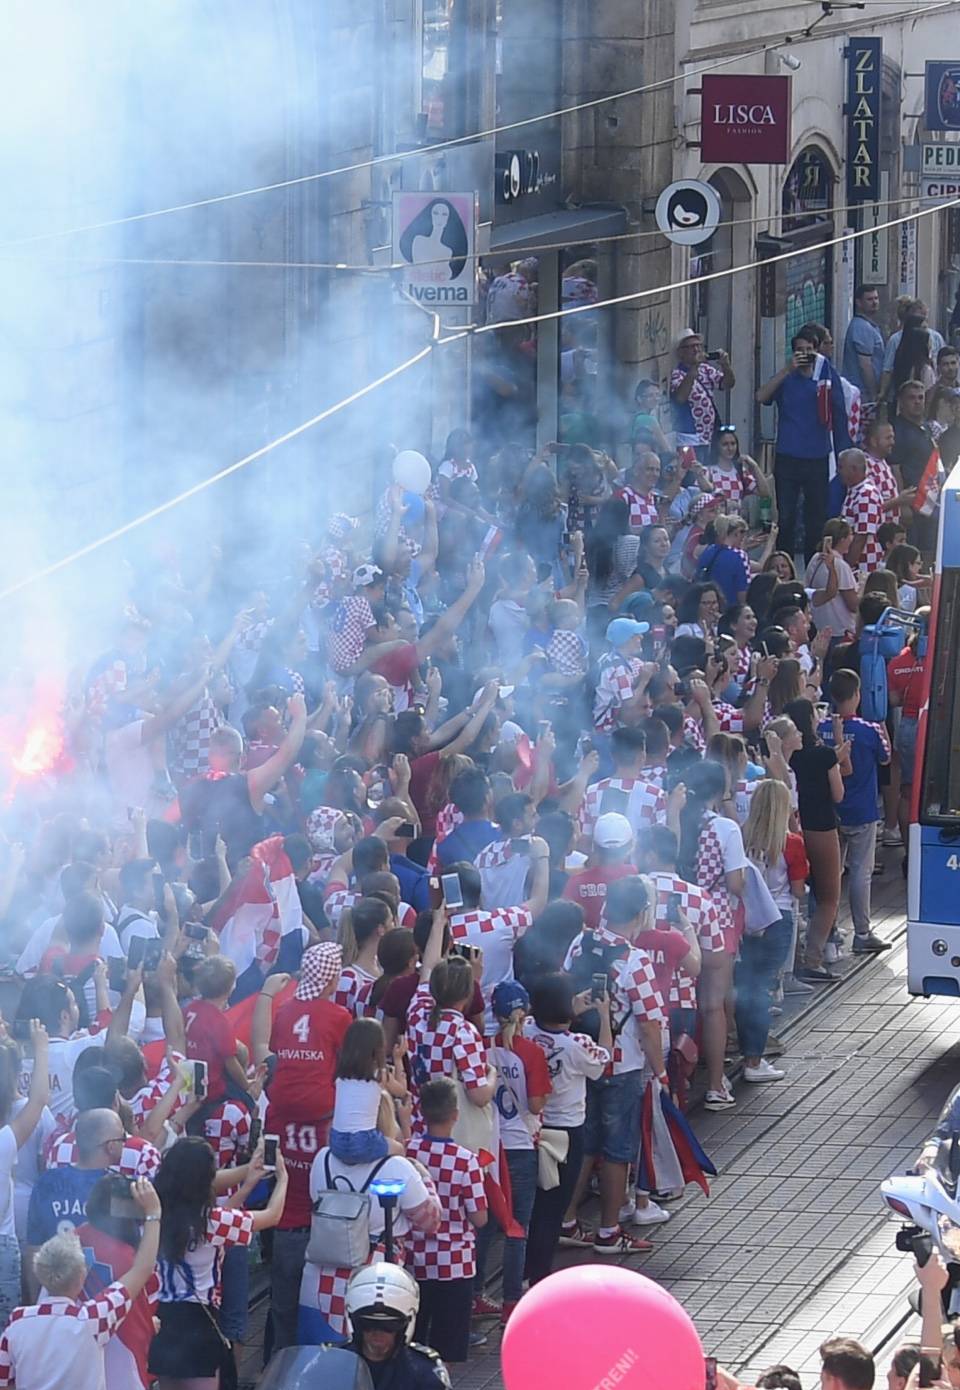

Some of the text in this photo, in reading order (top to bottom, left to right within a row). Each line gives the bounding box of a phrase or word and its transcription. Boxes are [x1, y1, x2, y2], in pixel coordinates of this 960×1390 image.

[713, 104, 777, 126] LISCA
[852, 48, 875, 187] ZLATAR
[292, 1013, 311, 1044] 4
[284, 1122, 318, 1154] 10
